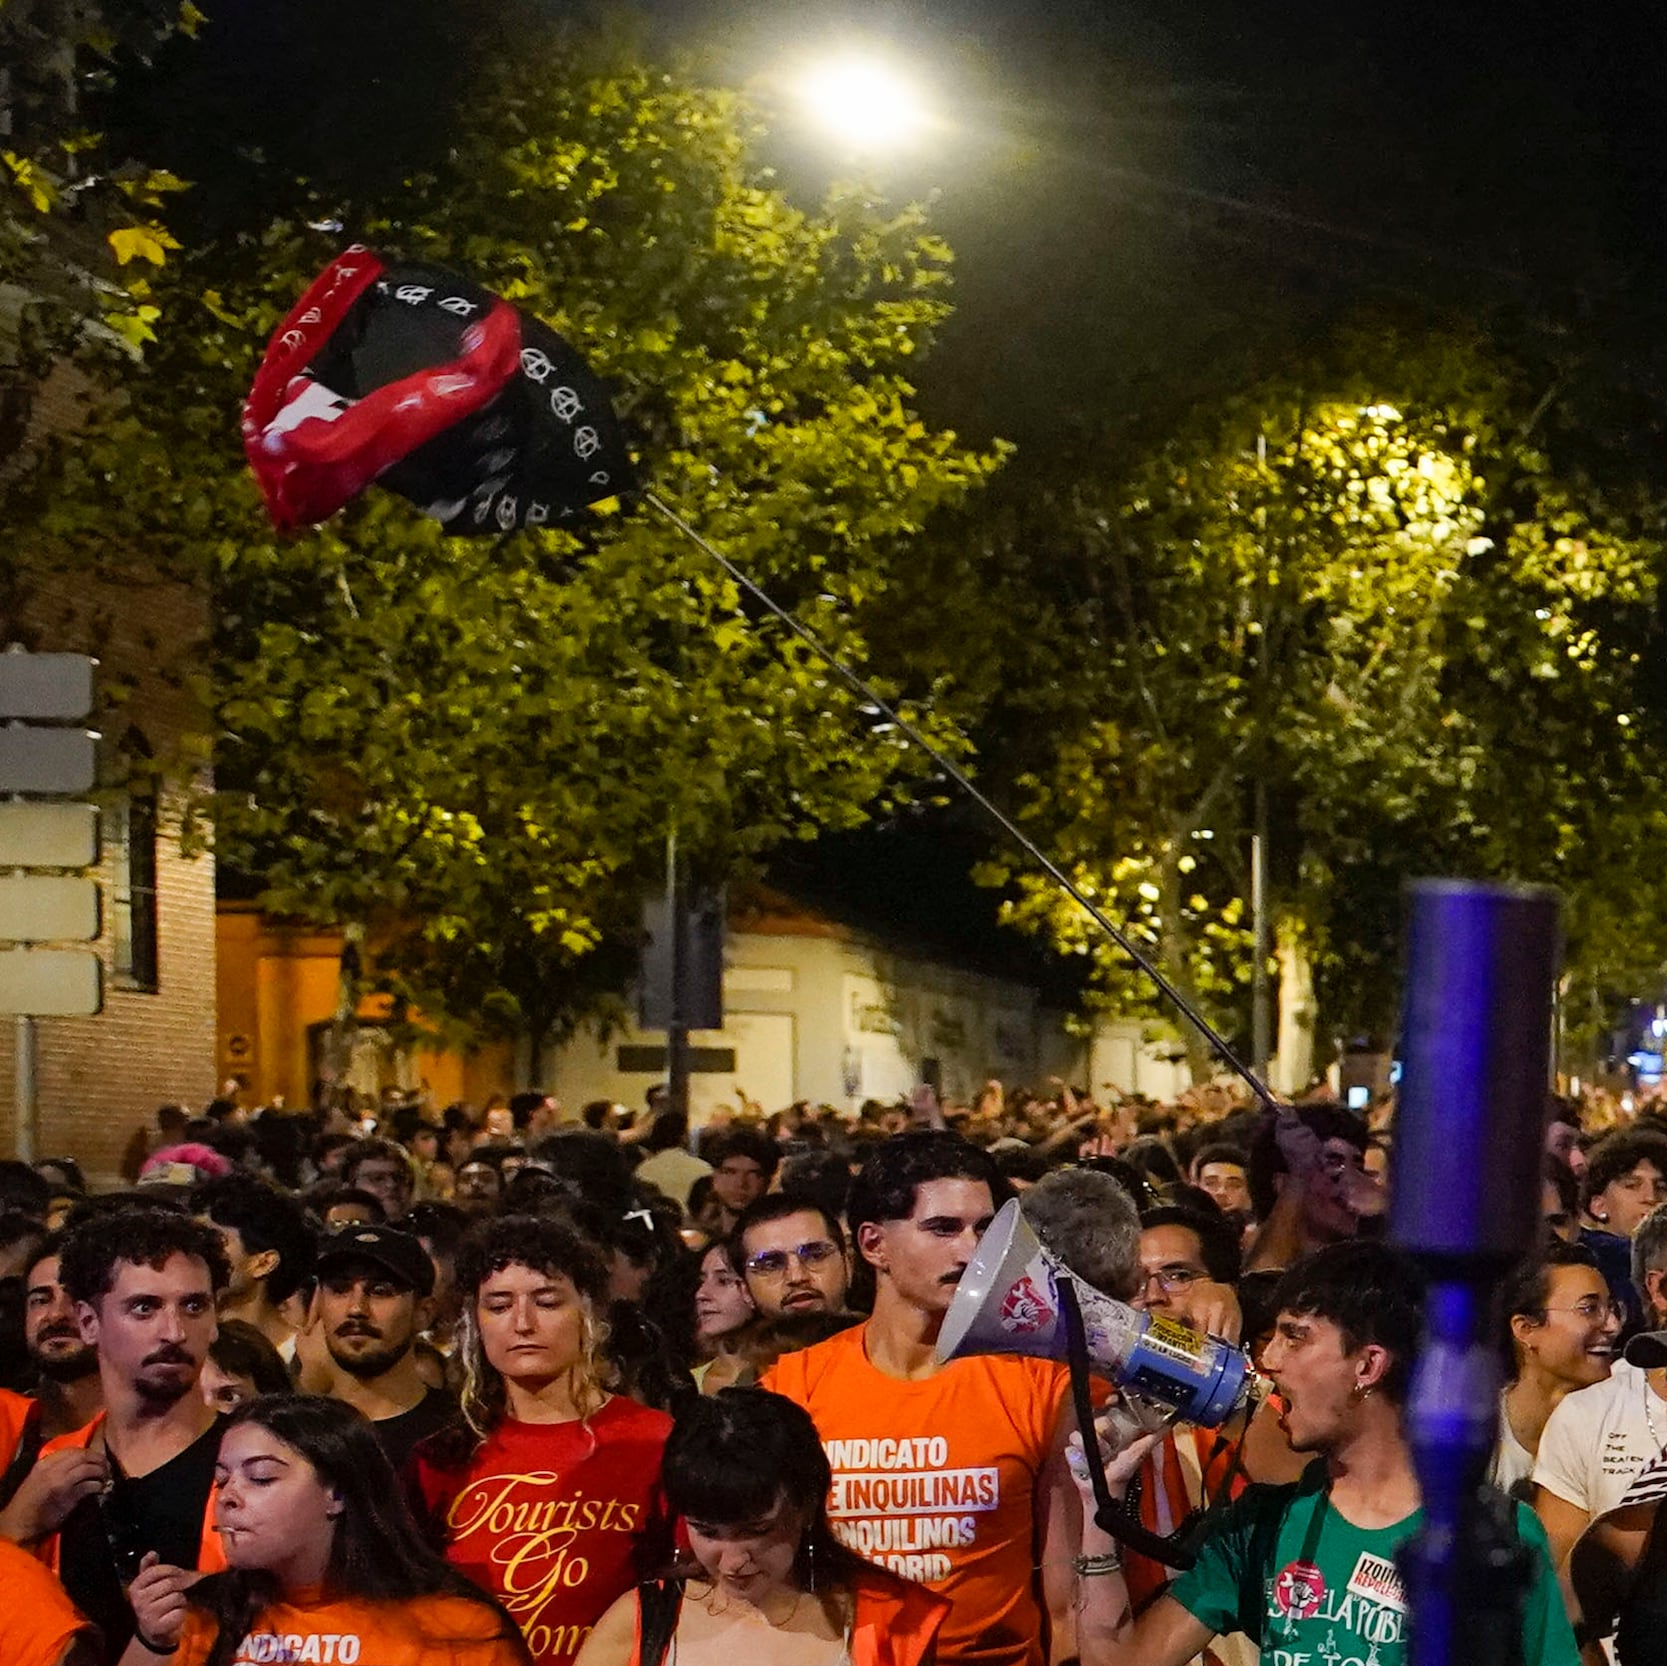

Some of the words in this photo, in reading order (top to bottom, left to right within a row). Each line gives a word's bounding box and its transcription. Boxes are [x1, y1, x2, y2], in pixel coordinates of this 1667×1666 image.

[822, 1437, 948, 1470] INDICATO
[447, 1470, 640, 1541] Tourists
[846, 1474, 994, 1512] INQUILINAS
[490, 1526, 589, 1612] Go
